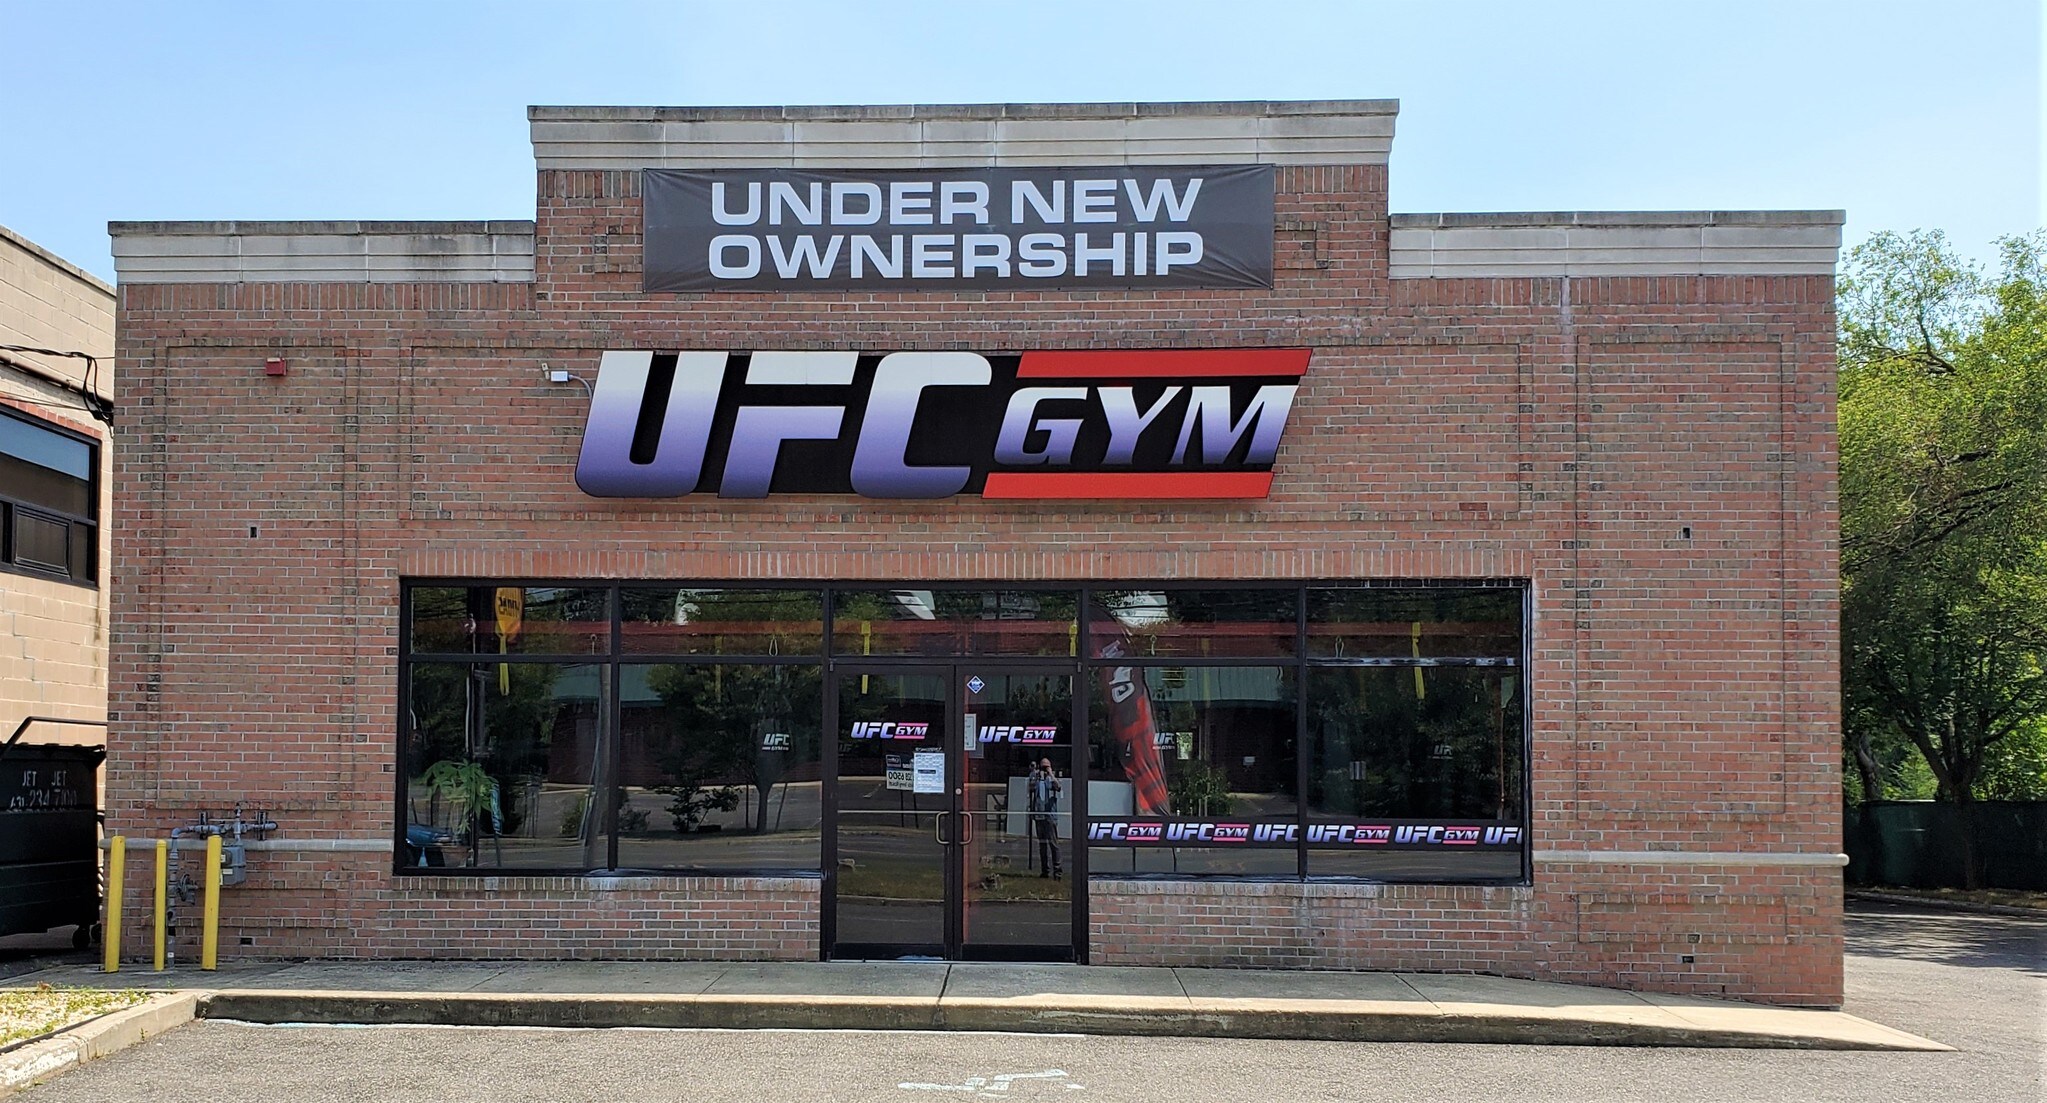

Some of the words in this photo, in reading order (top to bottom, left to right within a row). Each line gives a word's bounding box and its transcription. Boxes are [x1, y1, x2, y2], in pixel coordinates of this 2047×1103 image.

[711, 180, 989, 225] UNDER
[1012, 178, 1204, 223] NEW
[708, 231, 1204, 279] OWNERSHIP
[575, 351, 992, 498] UFC
[994, 385, 1299, 465] GYM
[763, 733, 789, 745] UFC
[851, 722, 896, 739] UFC
[895, 726, 928, 736] GYM
[978, 725, 1024, 743] UFC
[1023, 730, 1056, 739] GYM
[22, 770, 37, 786] JET
[51, 770, 67, 786] JET
[1128, 827, 1161, 837] GYM
[1166, 823, 1215, 840] UFC
[1214, 827, 1248, 837] GYM
[1253, 823, 1298, 841] UFC
[1306, 825, 1355, 843] UFC
[1355, 829, 1389, 839] GYM
[1394, 826, 1445, 844] UFC
[1444, 830, 1479, 840] GYM
[1484, 826, 1522, 844] UF
